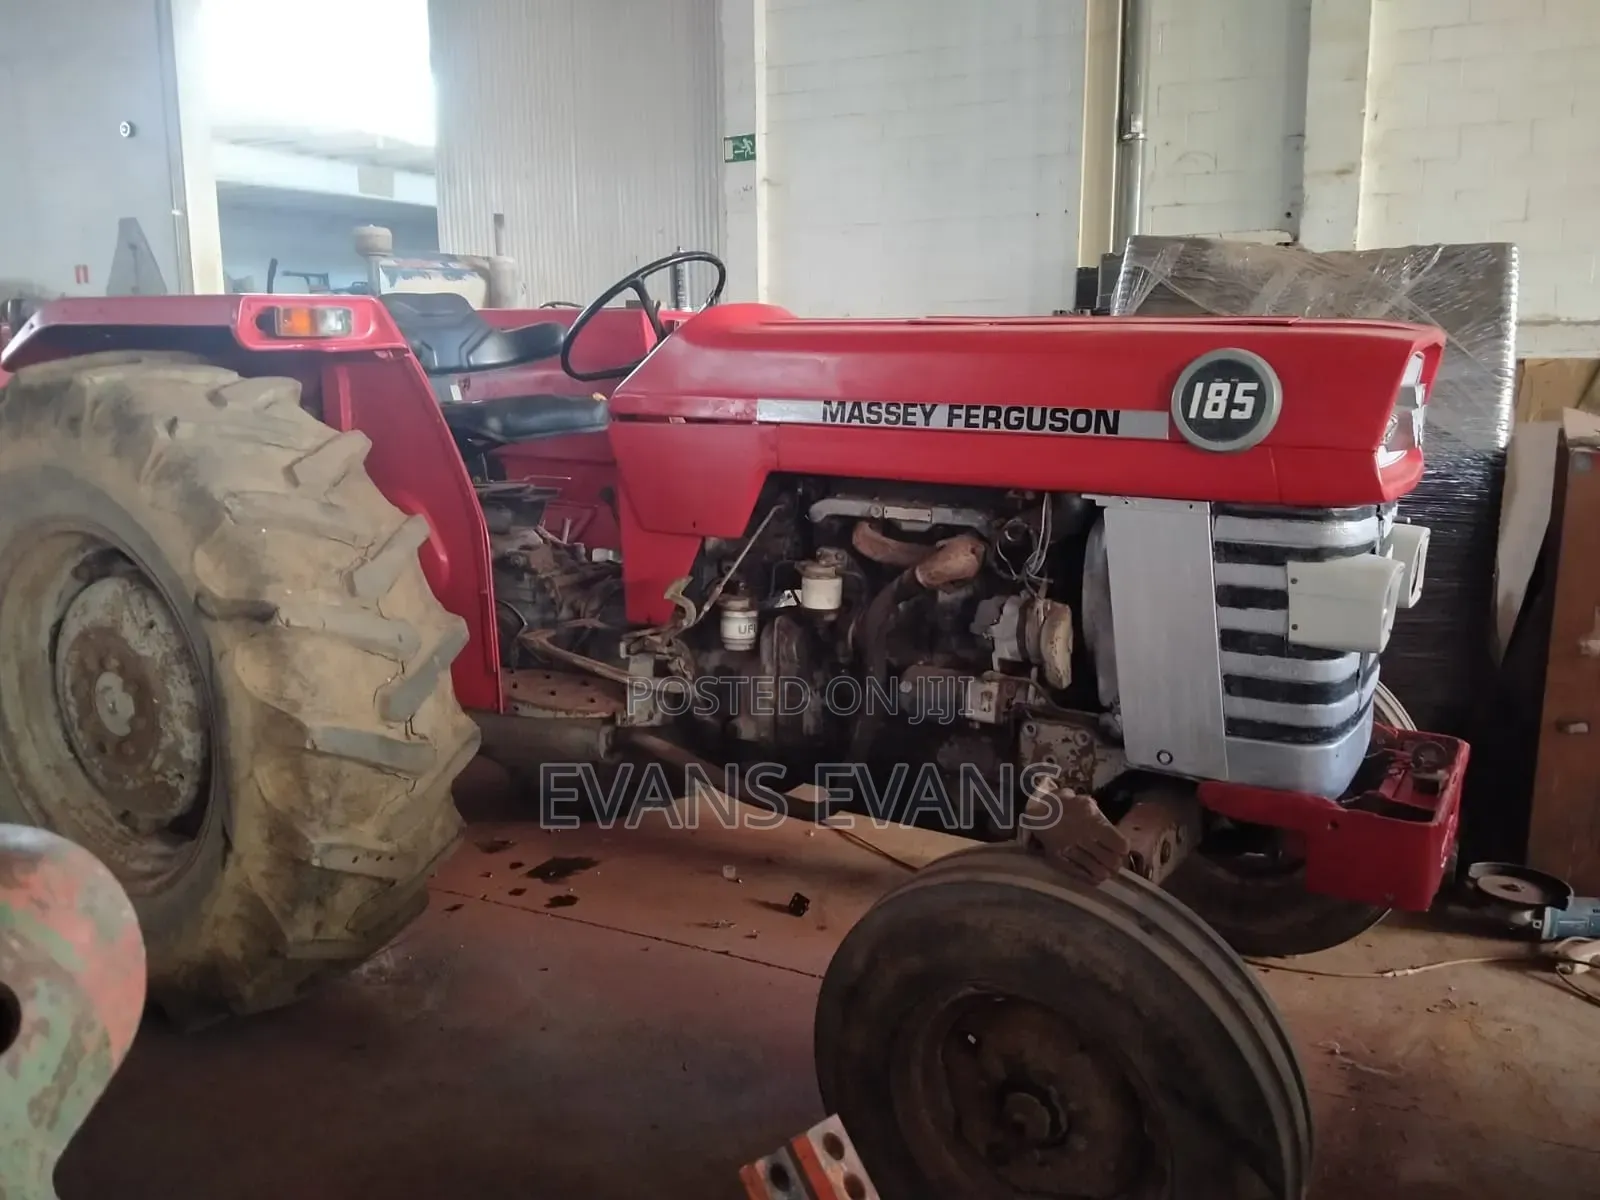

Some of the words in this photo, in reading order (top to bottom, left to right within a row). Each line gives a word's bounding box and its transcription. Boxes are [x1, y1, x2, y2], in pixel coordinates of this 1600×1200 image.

[822, 400, 938, 427] MASSEY
[946, 404, 1121, 435] FERGUSON
[1188, 382, 1259, 419] 185
